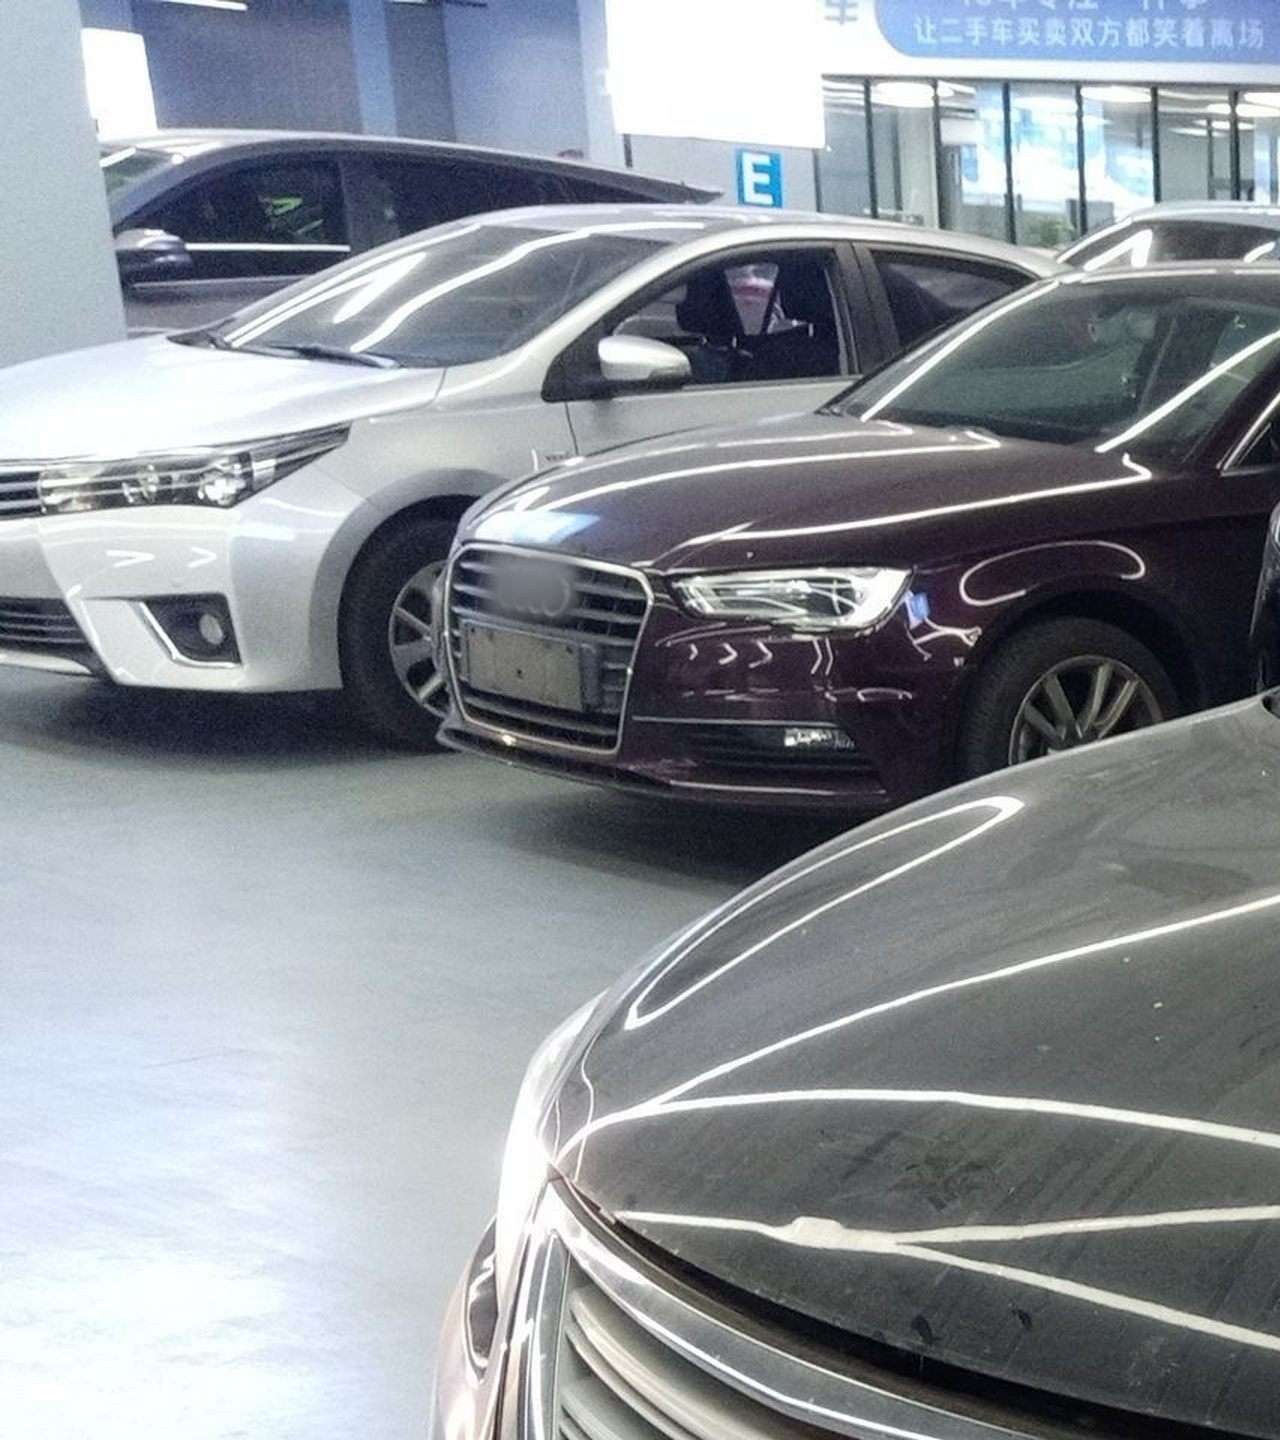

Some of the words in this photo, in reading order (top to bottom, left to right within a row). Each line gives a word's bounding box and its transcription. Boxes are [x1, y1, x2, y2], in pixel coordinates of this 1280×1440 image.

[914, 17, 1264, 48] 让二手车买卖双方都笑着离场
[742, 152, 774, 205] E
